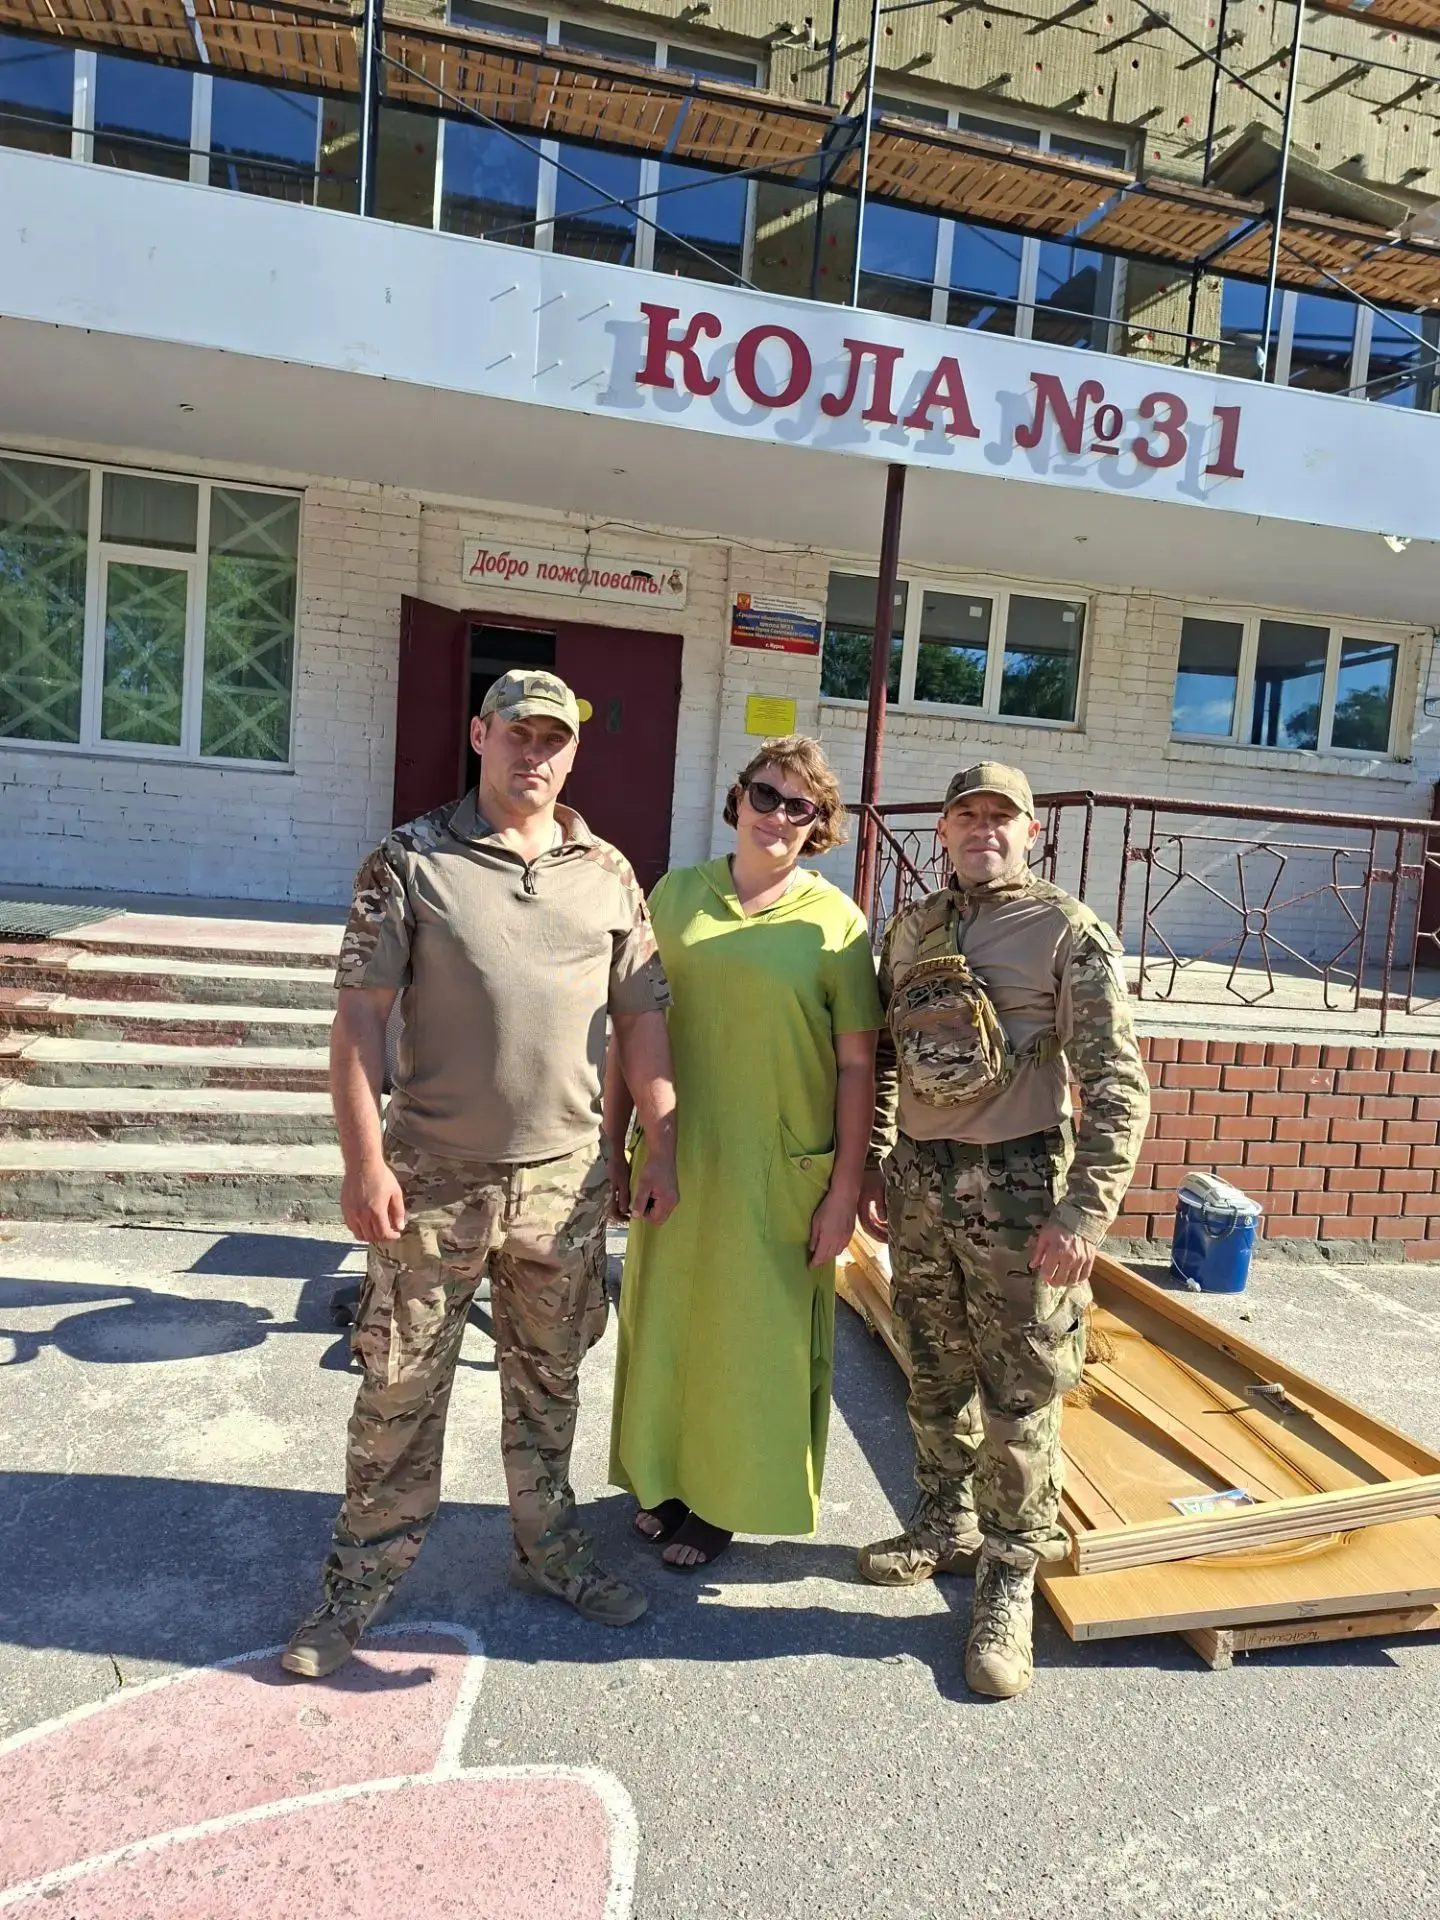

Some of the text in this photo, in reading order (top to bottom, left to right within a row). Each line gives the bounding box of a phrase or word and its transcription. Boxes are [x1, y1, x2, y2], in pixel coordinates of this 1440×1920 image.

[635, 301, 1244, 479] КОЛА №31
[469, 549, 666, 595] Добро пожаловать!
